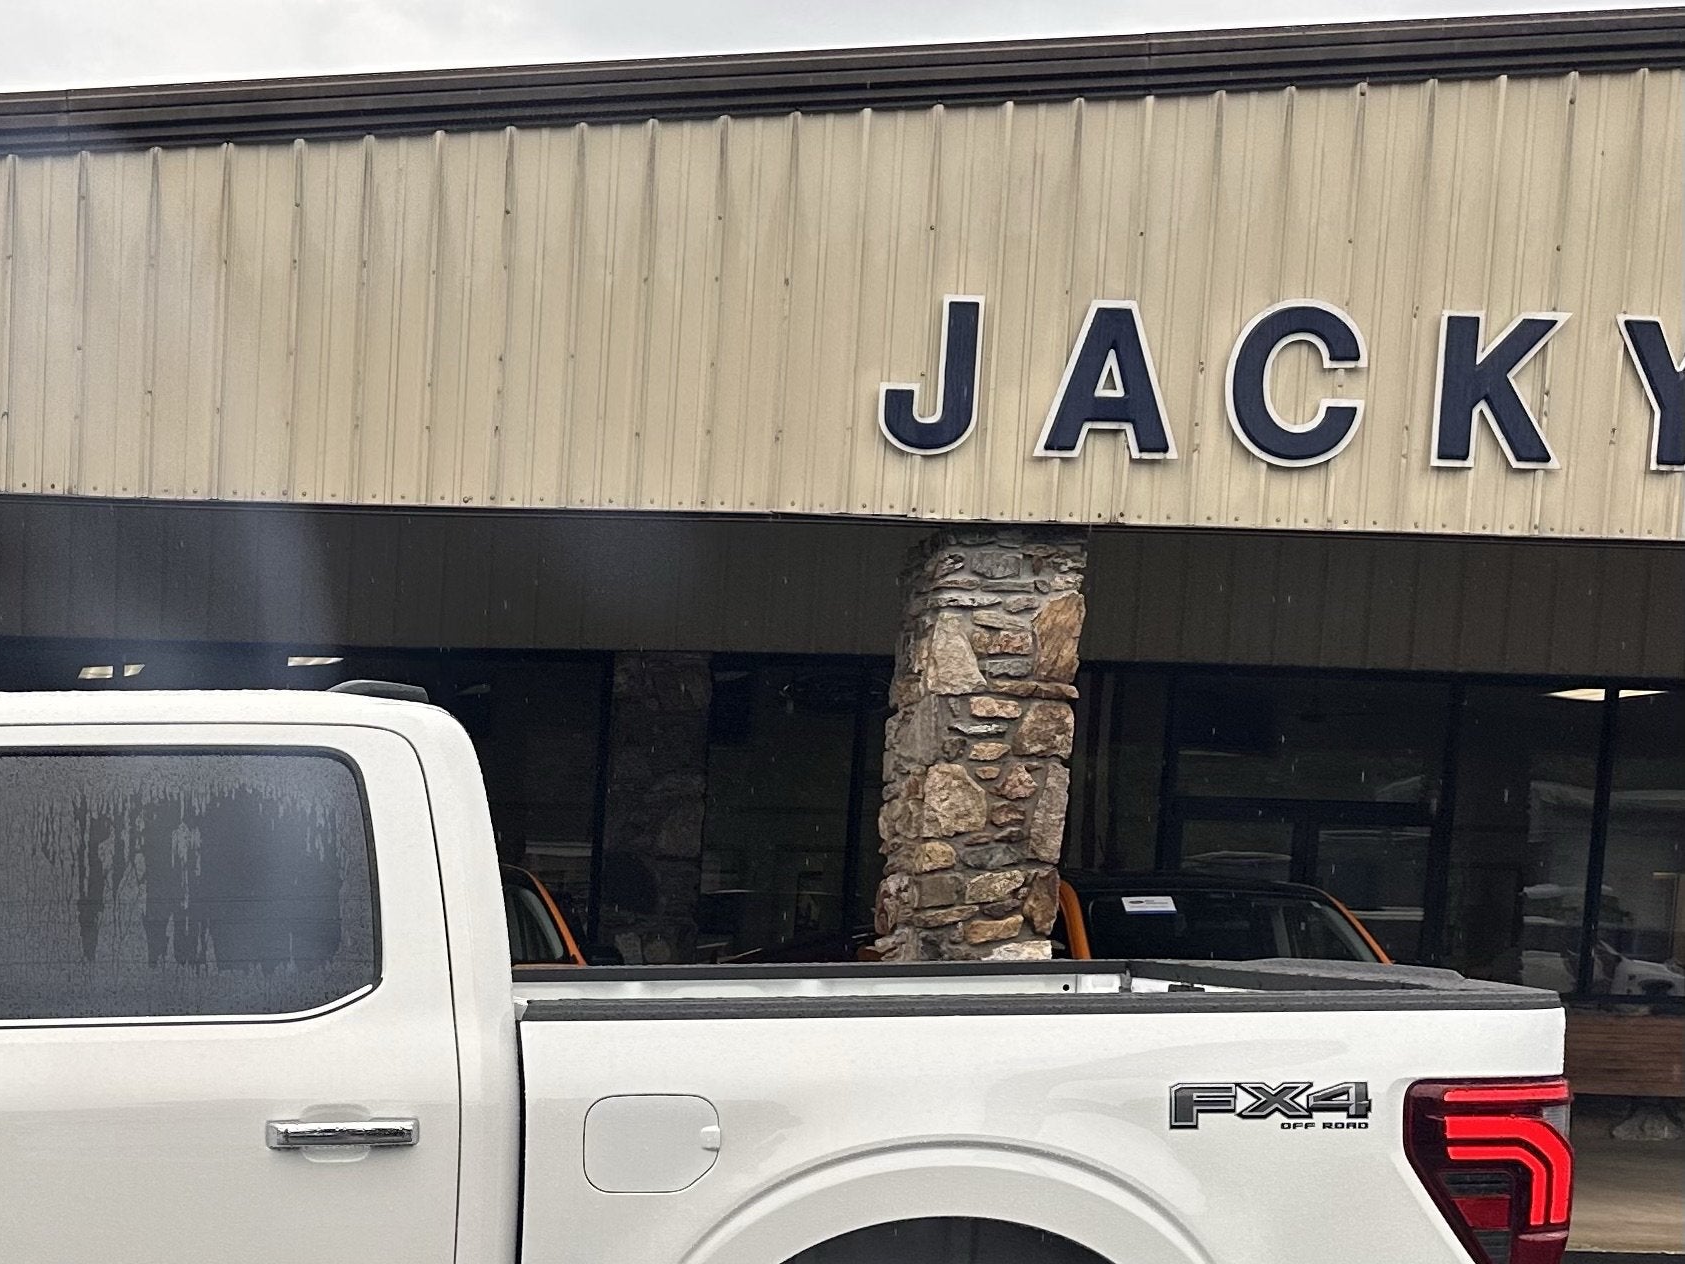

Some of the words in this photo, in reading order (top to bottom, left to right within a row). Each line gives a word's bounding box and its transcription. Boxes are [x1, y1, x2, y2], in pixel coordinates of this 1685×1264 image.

[1169, 1081, 1371, 1130] FX4
[1280, 1122, 1316, 1130] OFF
[1323, 1122, 1369, 1130] ROAD
